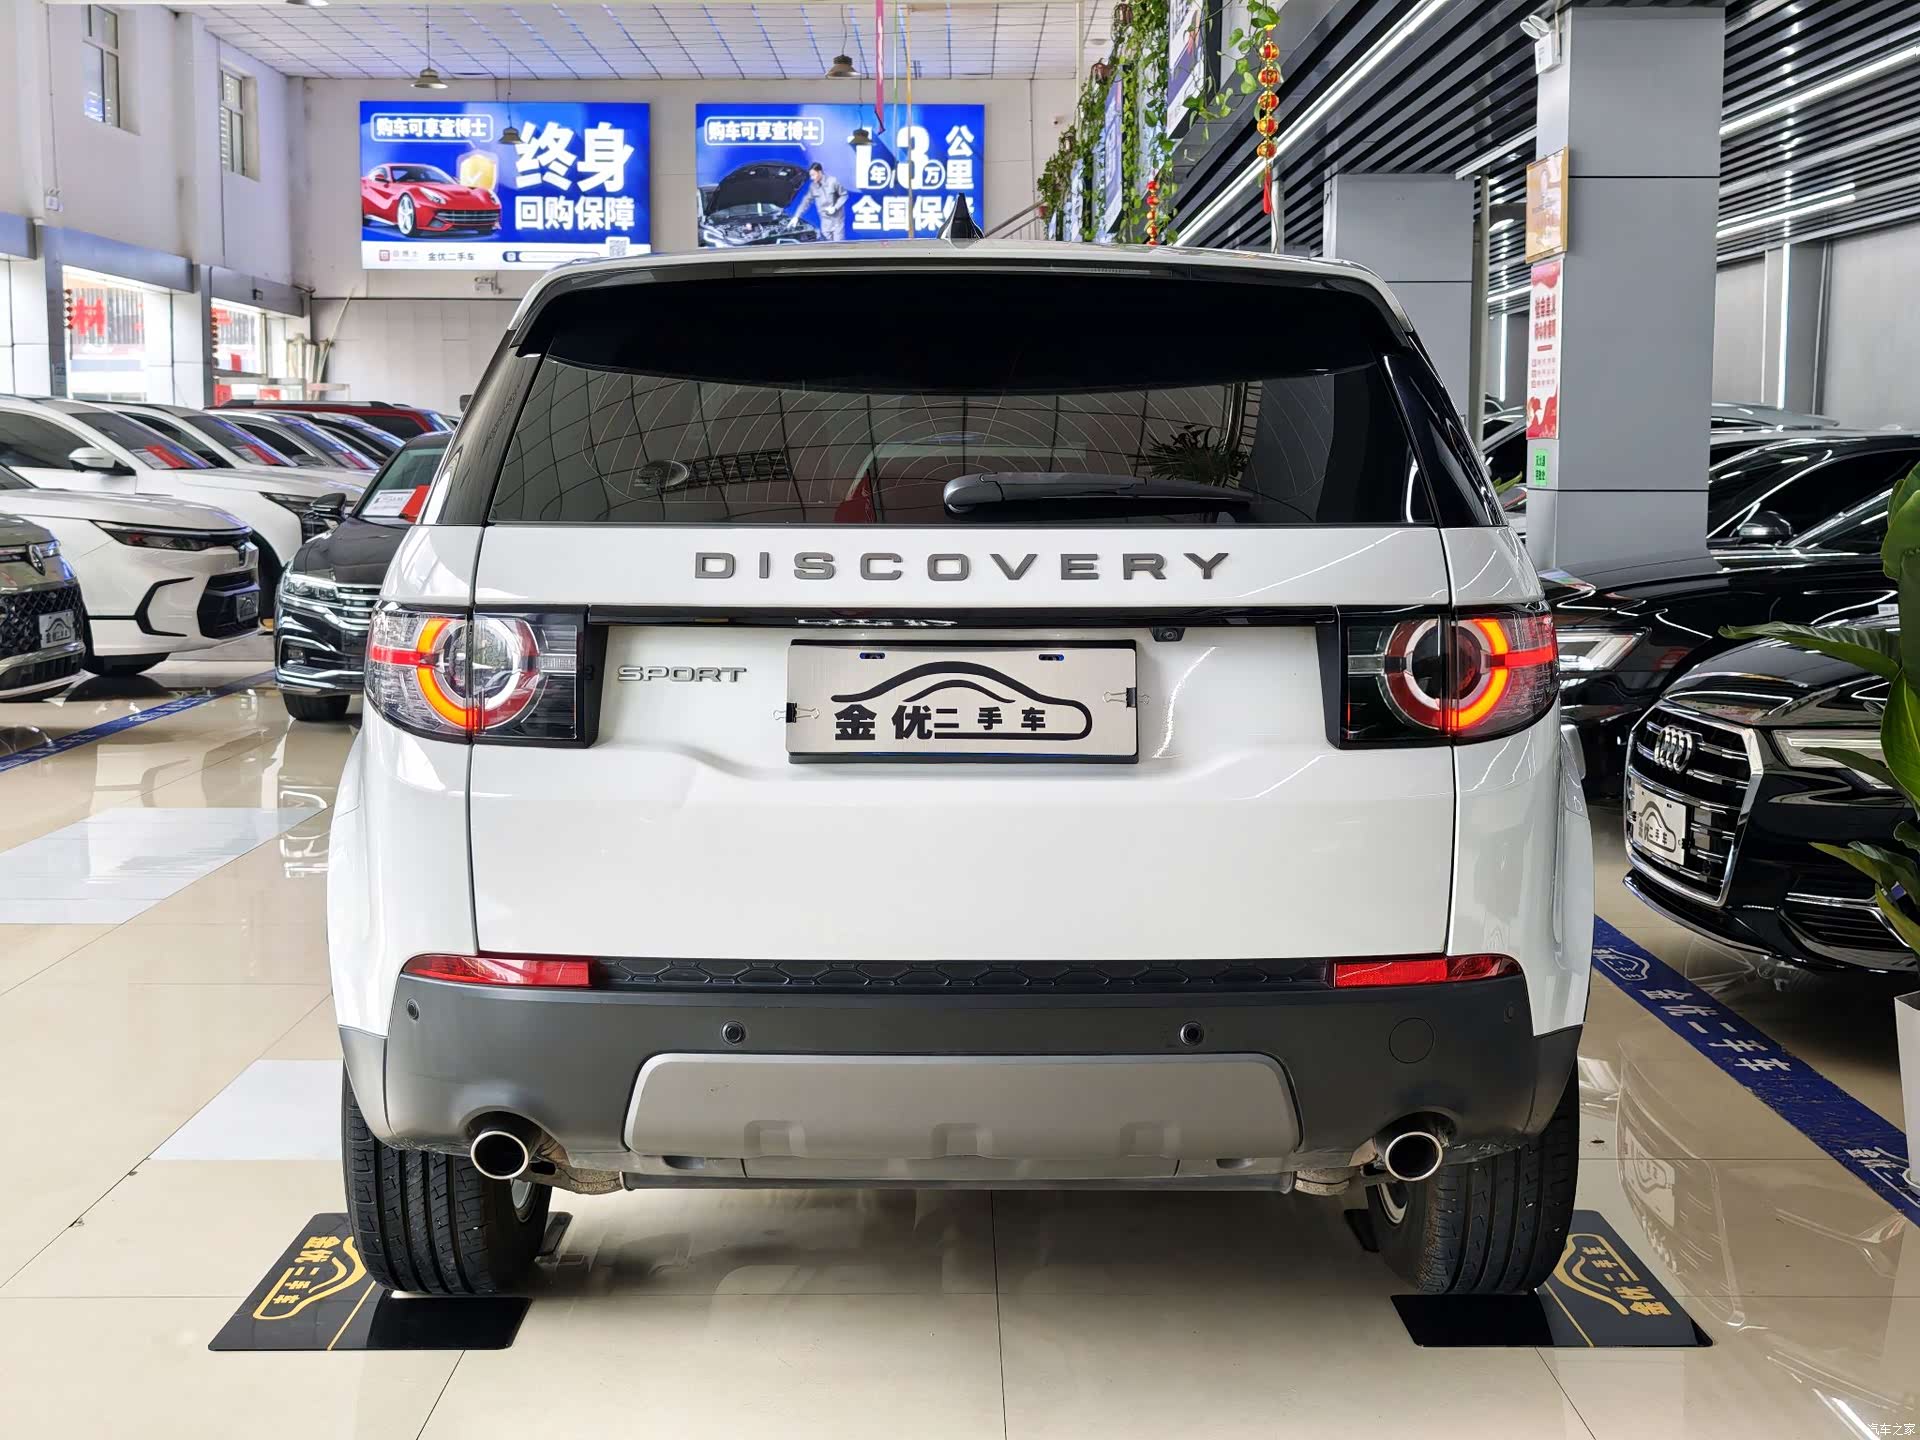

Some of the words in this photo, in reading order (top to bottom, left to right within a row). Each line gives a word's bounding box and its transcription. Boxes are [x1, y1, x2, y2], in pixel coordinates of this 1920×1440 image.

[376, 117, 487, 139] 购车可享查博士
[707, 121, 820, 142] 购车可享查博士
[514, 120, 635, 192] 终身
[514, 196, 635, 232] 回购保障
[428, 252, 475, 261] 金优二手车
[694, 551, 1230, 582] DISCOVERY
[615, 665, 747, 684] SPORT
[834, 704, 1047, 741] 金优二手车
[1639, 988, 1791, 1072] 金优二手车
[273, 1235, 341, 1304] 金优二手车
[1582, 1246, 1673, 1316] 金优二手车
